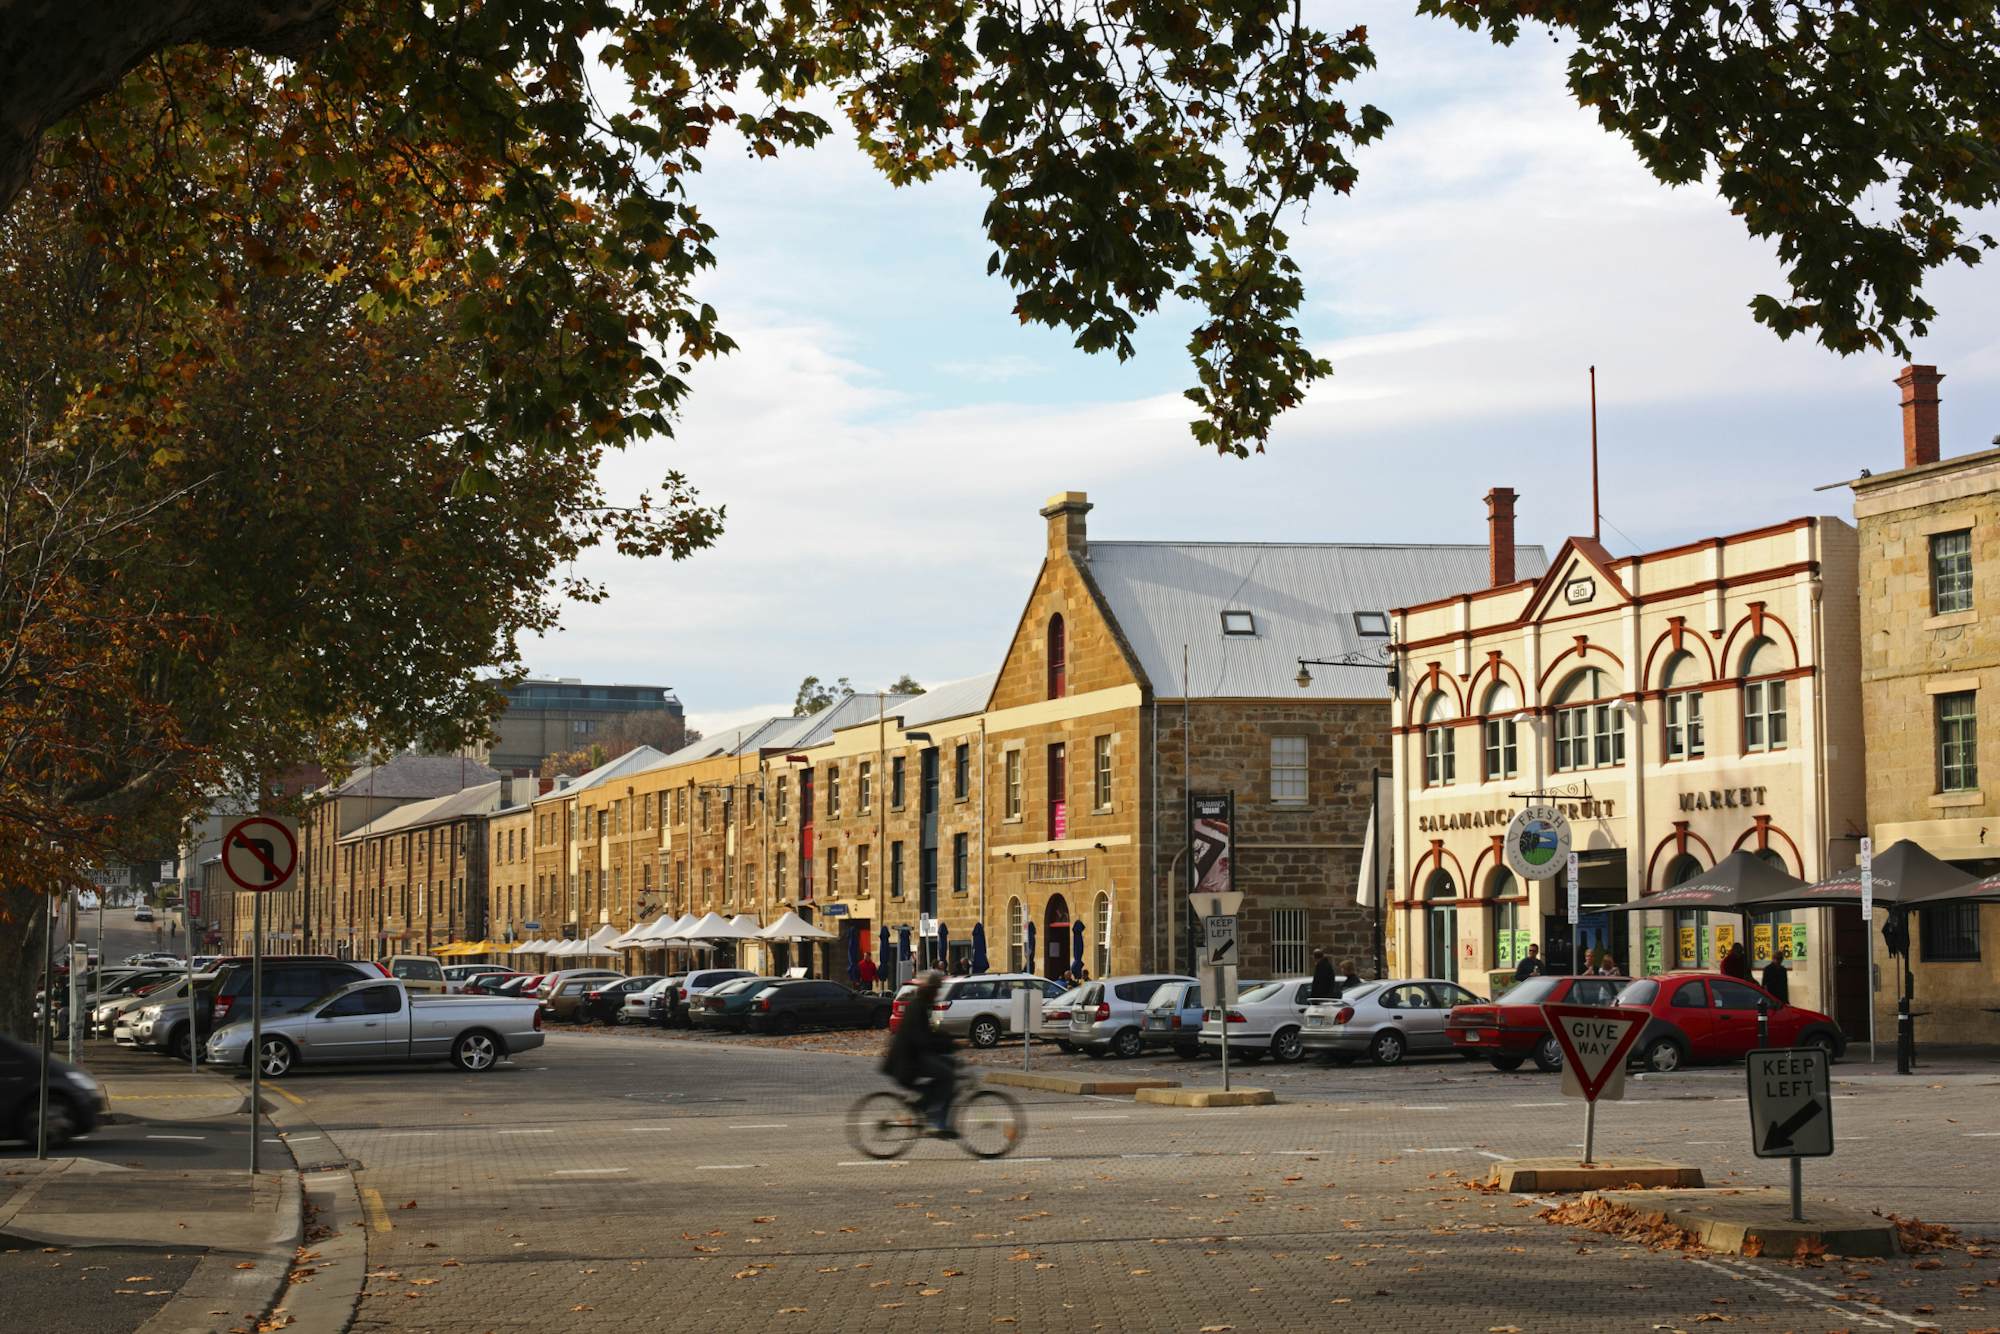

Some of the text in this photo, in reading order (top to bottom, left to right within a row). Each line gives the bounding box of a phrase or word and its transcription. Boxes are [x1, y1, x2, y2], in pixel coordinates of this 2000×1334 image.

[1418, 785, 1768, 833] SALAMANCA FRUIT MARKET
[1518, 807, 1566, 830] FRESH
[1210, 919, 1233, 928] KEEP
[1211, 929, 1232, 938] LEFT
[1572, 1022, 1619, 1040] GIVE
[1577, 1041, 1610, 1056] WAY
[1763, 1059, 1815, 1076] KEEP
[1766, 1080, 1814, 1098] LEFT
